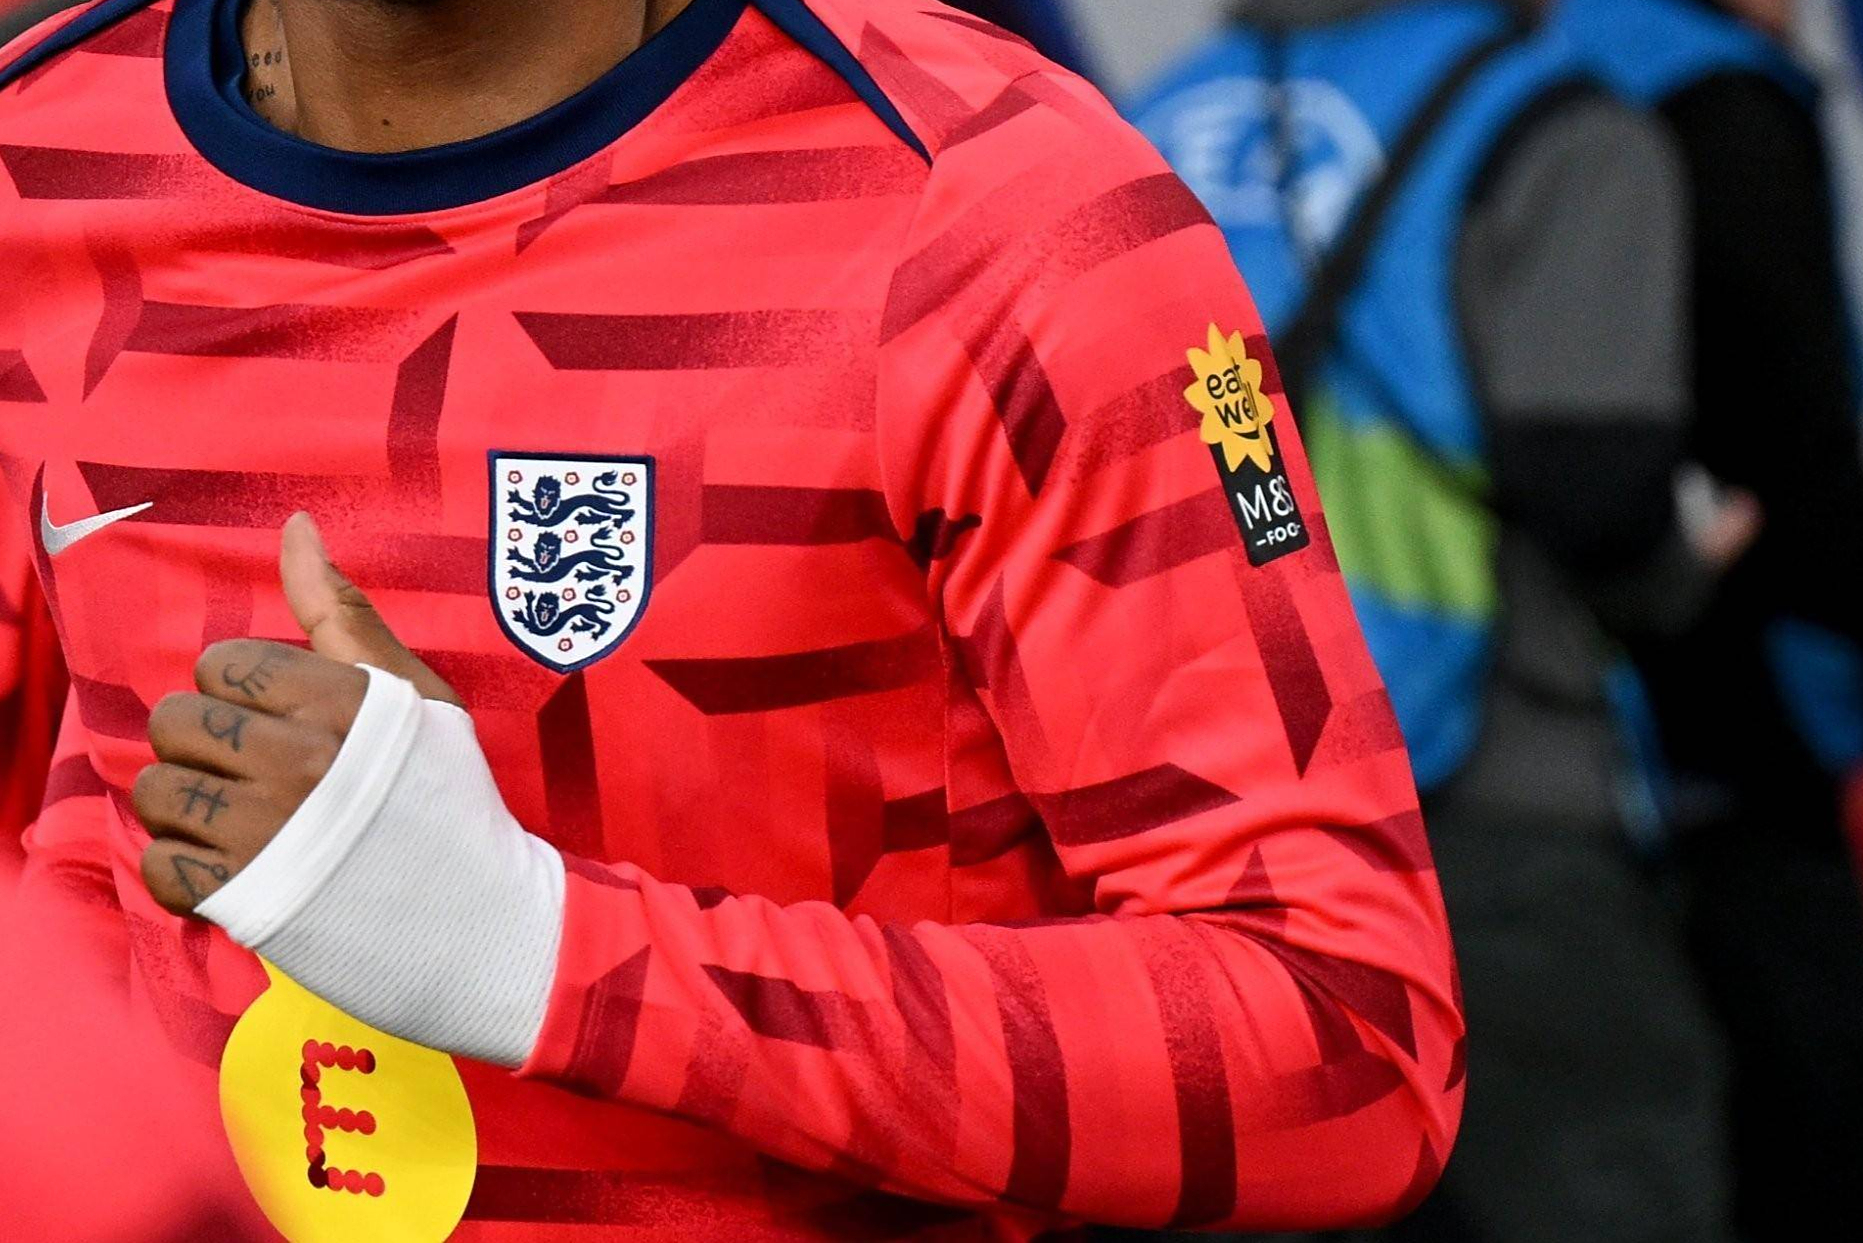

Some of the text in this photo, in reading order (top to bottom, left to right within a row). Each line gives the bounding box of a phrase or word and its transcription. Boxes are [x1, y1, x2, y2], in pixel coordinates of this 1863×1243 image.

[1205, 364, 1242, 400] ea
[1214, 382, 1259, 429] we
[300, 1039, 385, 1198] E
